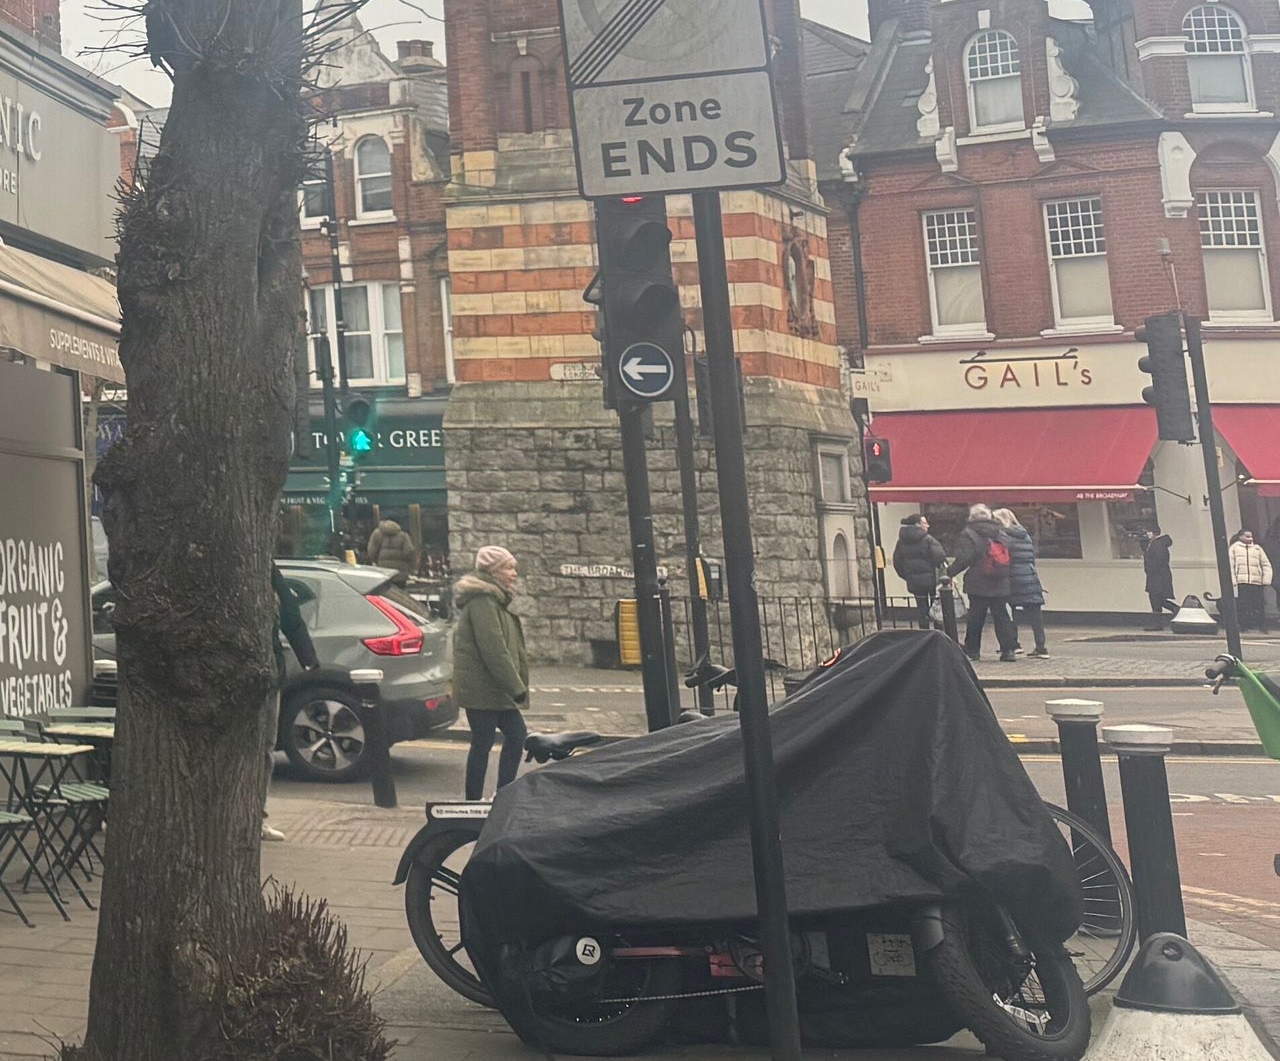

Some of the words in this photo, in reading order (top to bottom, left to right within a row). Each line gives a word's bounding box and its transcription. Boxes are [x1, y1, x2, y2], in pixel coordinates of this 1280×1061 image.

[623, 96, 722, 127] Zone
[601, 130, 758, 178] ENDS
[389, 430, 446, 448] GREE
[51, 598, 68, 665] &
[1, 670, 72, 717] VEGETABLES
